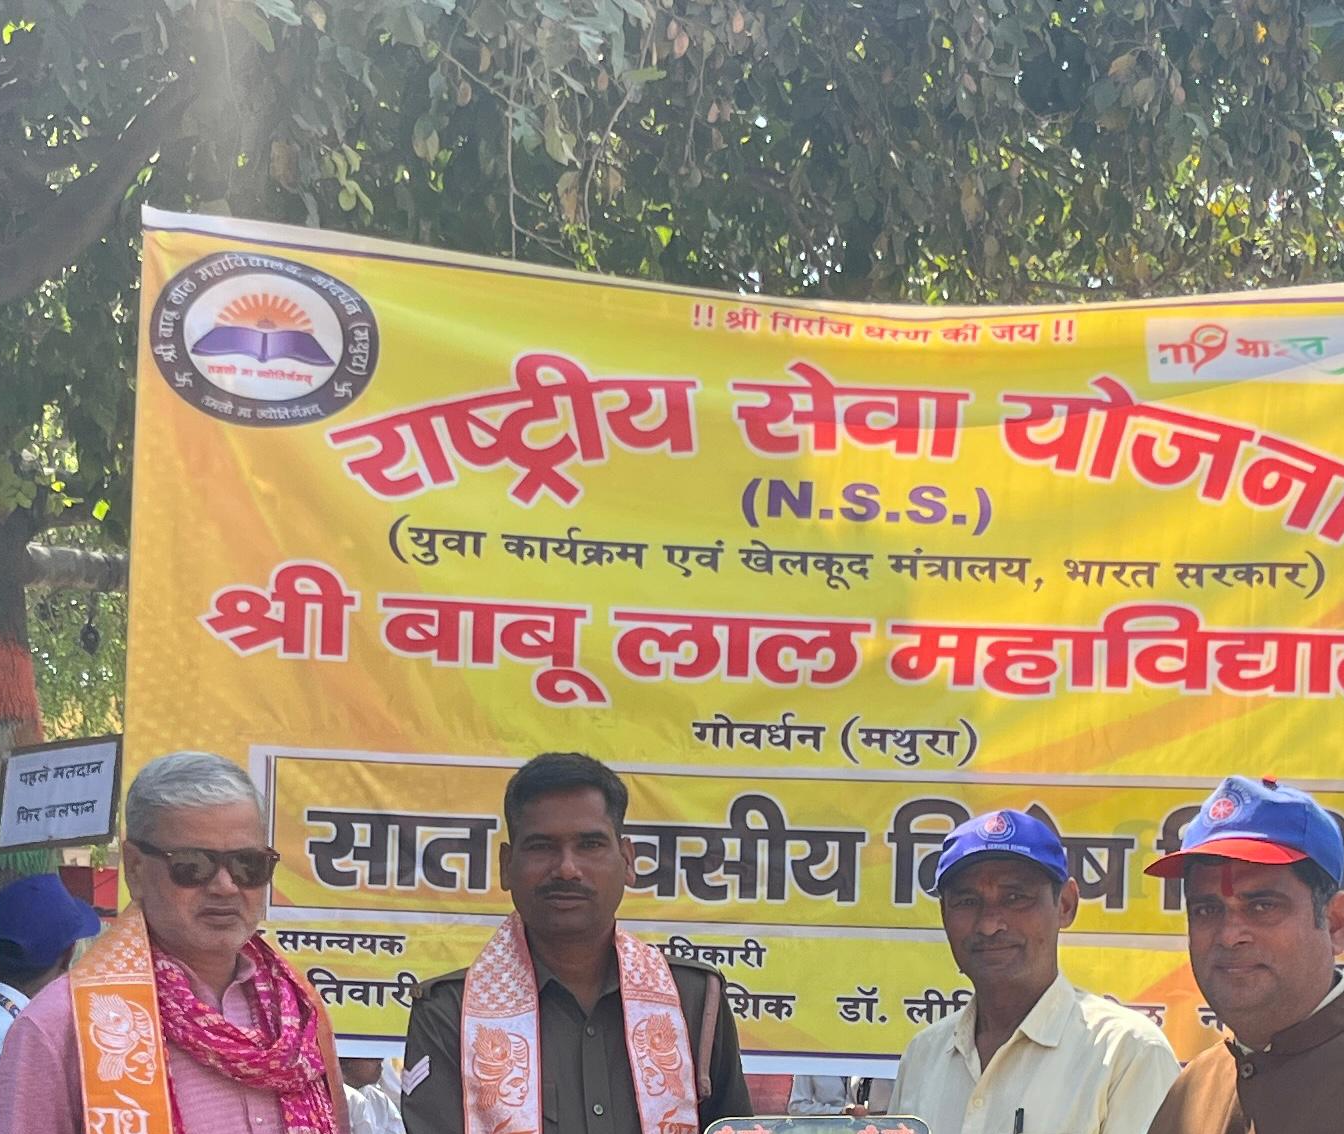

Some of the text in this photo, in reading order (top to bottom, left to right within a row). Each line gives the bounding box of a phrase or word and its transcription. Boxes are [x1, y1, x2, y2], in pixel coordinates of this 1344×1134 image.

[725, 308, 761, 332] श्री
[941, 321, 981, 344] की
[992, 322, 1040, 343] जय
[330, 354, 697, 505] राष्ट्रीय
[732, 362, 969, 457] सेवा
[742, 478, 992, 536] (N.S.S.)
[388, 514, 486, 567] (युवा
[503, 527, 646, 568] कार्यक्रम
[663, 541, 724, 578] एवं
[738, 541, 874, 590] खेलकूद
[1064, 557, 1160, 590] भारत
[1175, 550, 1327, 599] सरकार)
[206, 564, 354, 660] श्री
[382, 597, 609, 704] बाबू
[614, 610, 871, 686] लाल
[692, 713, 978, 766] गोवर्धन (मथुरा)
[19, 761, 104, 786] पहले मतदान
[17, 806, 42, 824] फिर
[306, 811, 500, 891] सात
[621, 794, 867, 903] वसीय
[276, 930, 406, 955] समन्वयक
[648, 936, 767, 968] धिकारी
[727, 982, 796, 1021] शिक
[836, 987, 888, 1024] डॉ.
